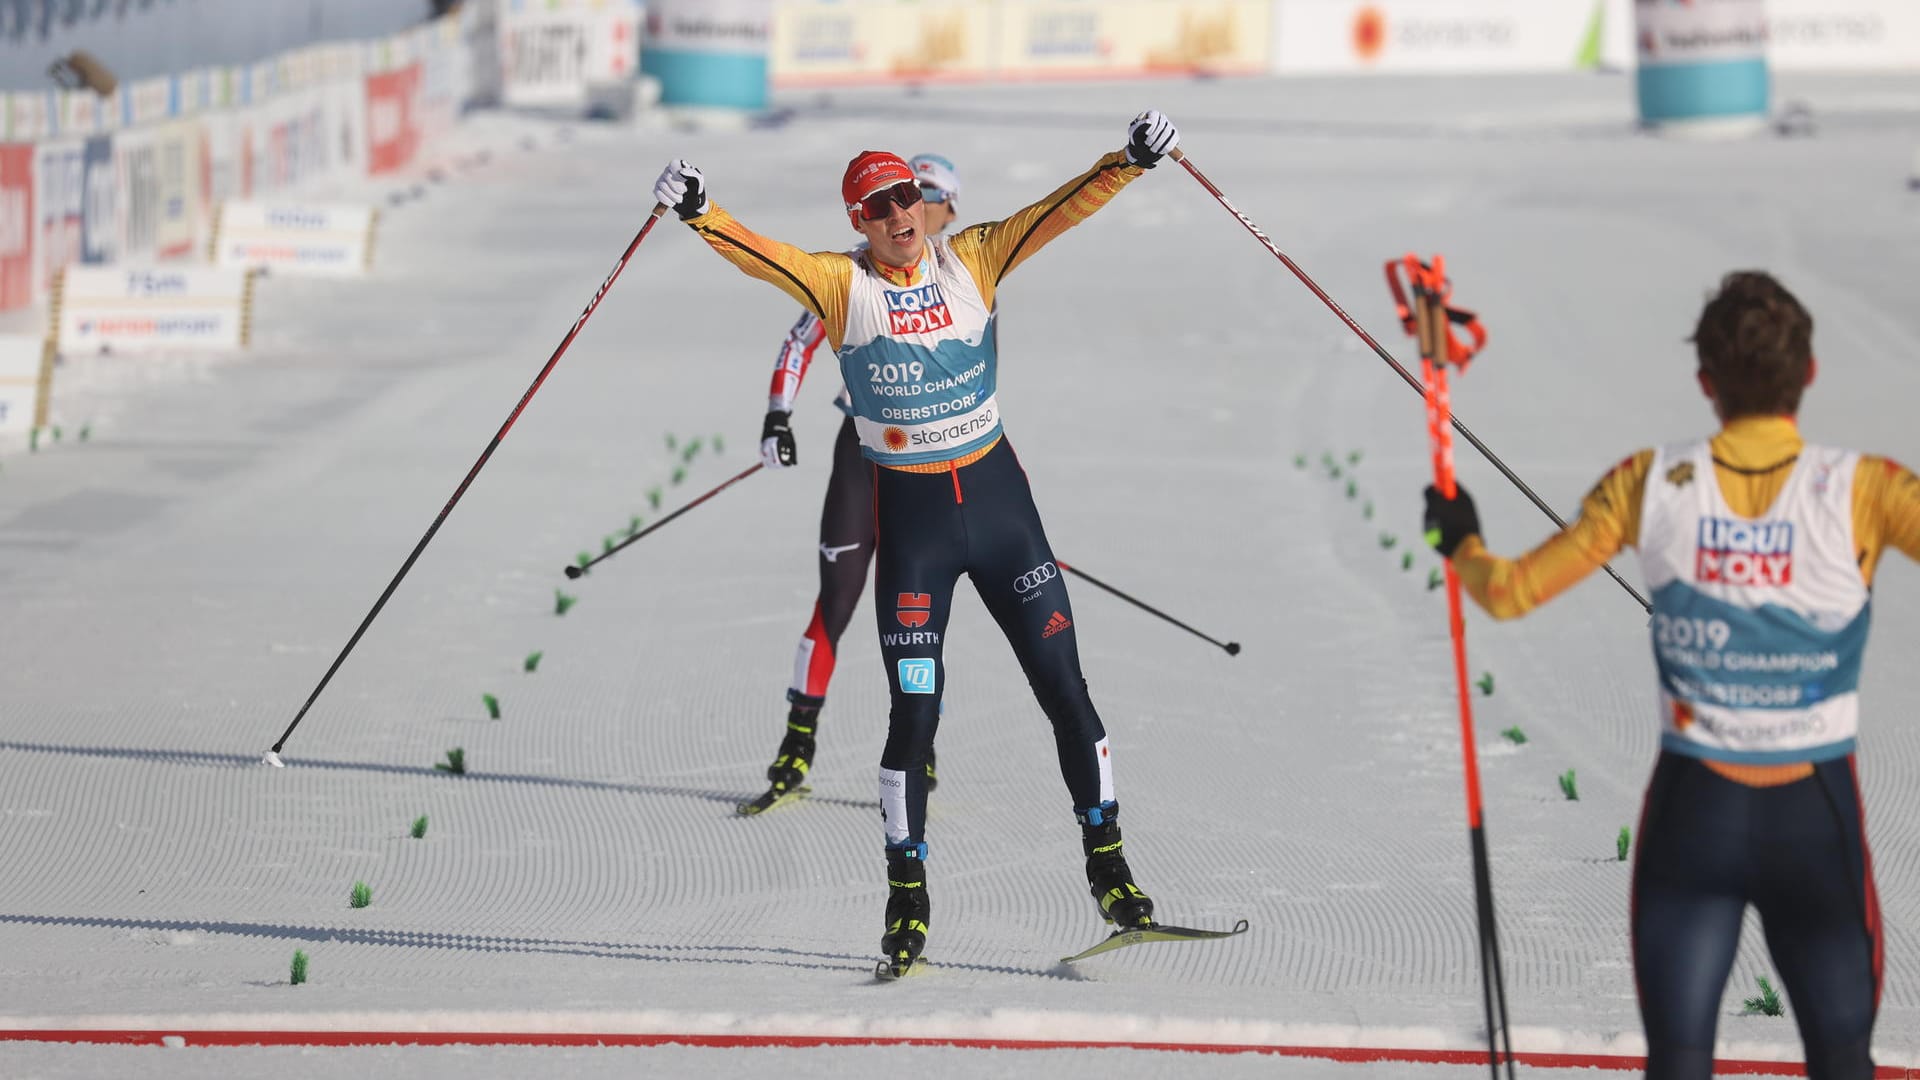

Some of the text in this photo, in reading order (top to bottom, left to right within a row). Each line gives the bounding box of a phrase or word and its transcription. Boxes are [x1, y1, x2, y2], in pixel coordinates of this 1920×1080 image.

[886, 283, 941, 312] LQUI
[892, 305, 946, 333] MOLY
[867, 361, 924, 383] 2019
[871, 360, 986, 397] WORLD CHAMPION
[881, 392, 977, 420] OBERSTDORF
[911, 409, 993, 445] storaenso
[1022, 590, 1042, 604] Audi
[883, 632, 939, 646] WÜRTH
[1041, 620, 1072, 639] adidas
[1656, 613, 1731, 650] 2019
[904, 664, 929, 689] TQ
